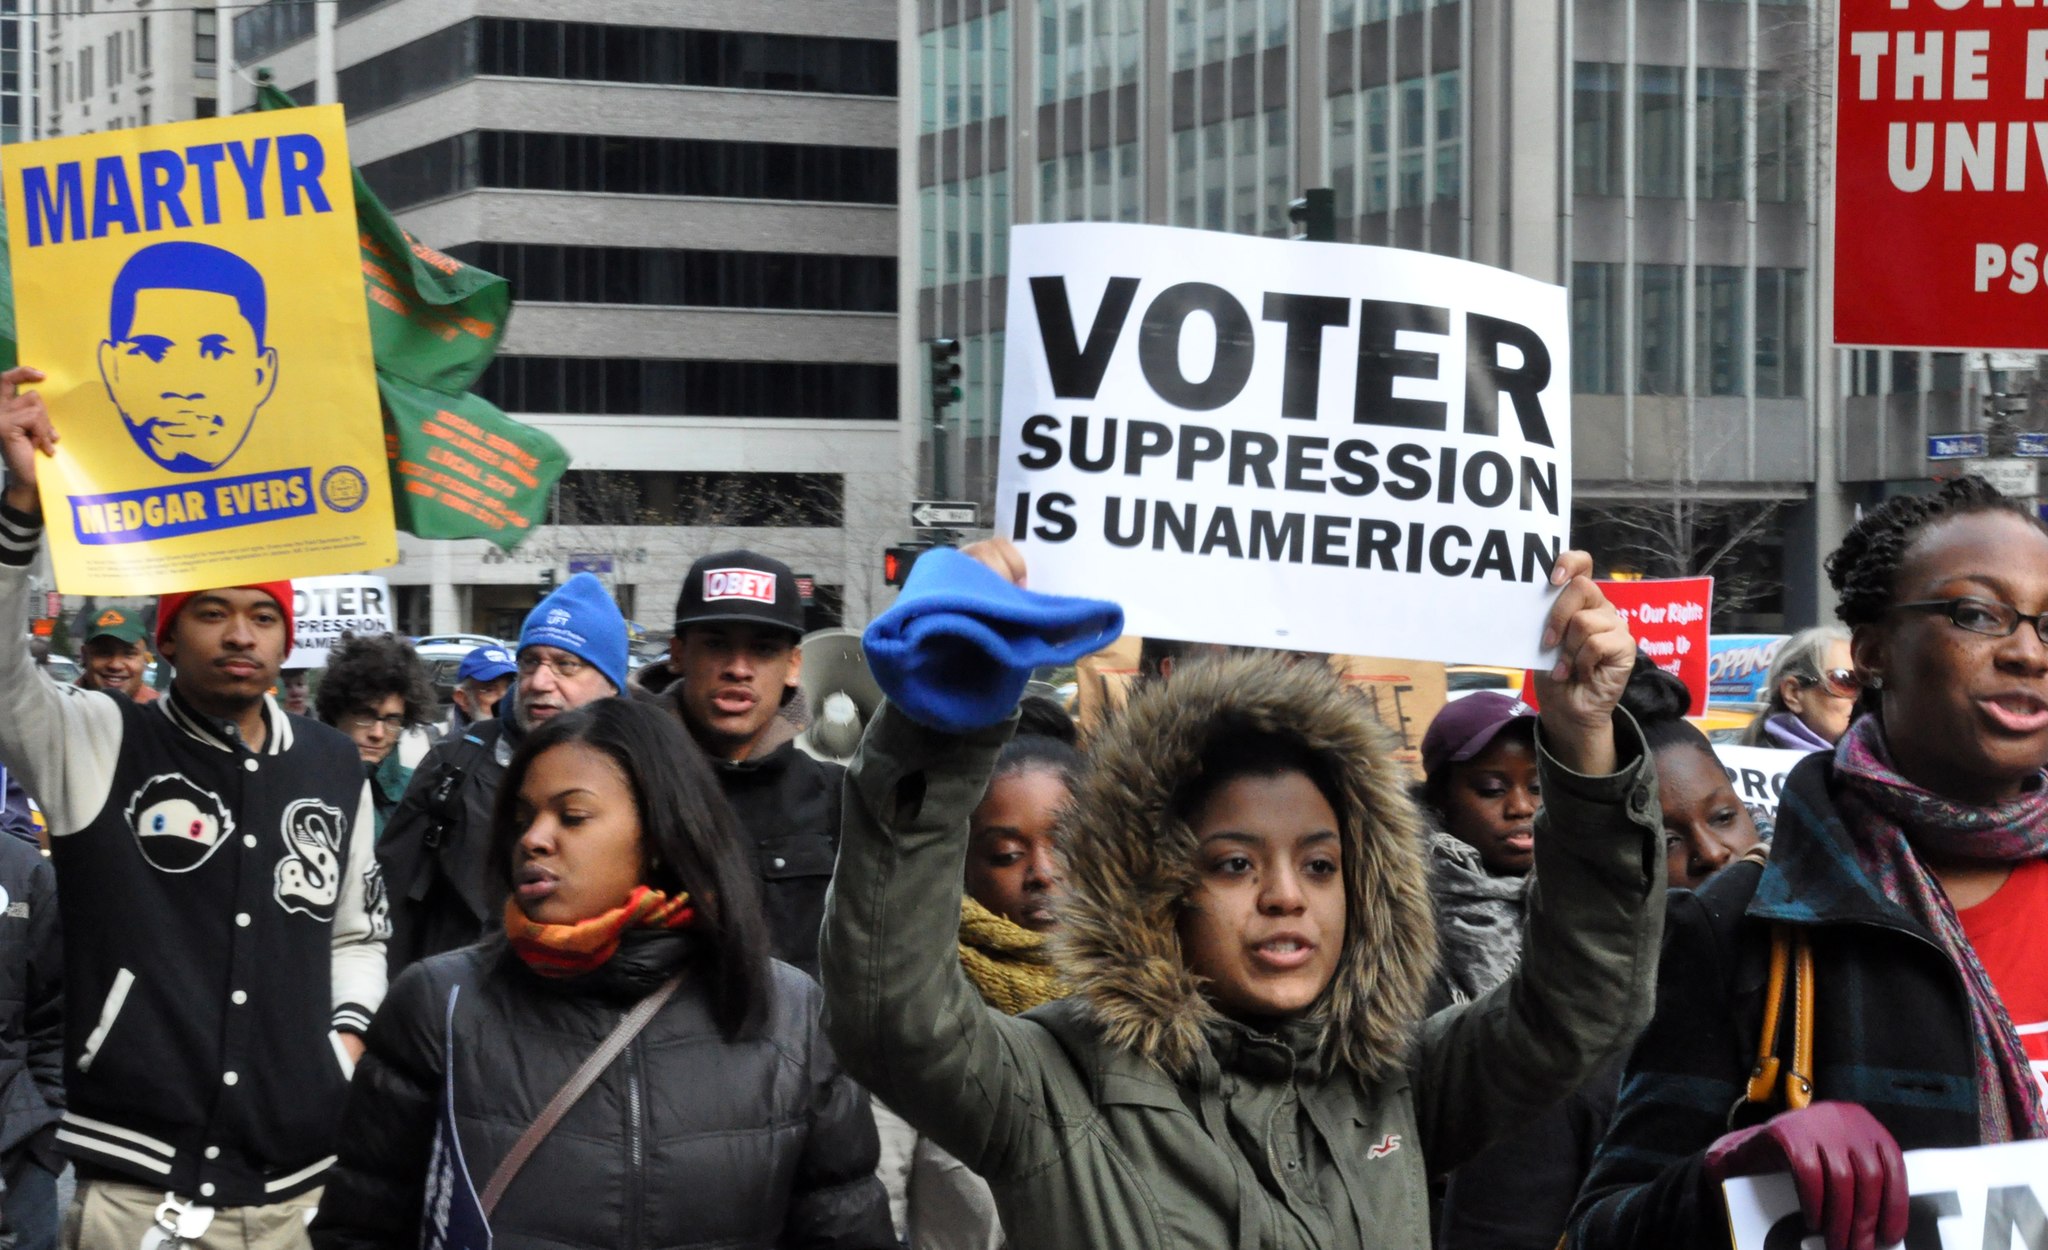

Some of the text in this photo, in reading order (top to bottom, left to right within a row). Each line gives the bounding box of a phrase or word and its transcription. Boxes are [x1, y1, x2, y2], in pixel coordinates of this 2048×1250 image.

[1851, 29, 1990, 100] THE
[21, 133, 333, 247] MARTYR
[1975, 243, 2048, 294] PS
[1028, 275, 1555, 449] VOTER
[1017, 414, 1559, 517] SUPPRESSION
[77, 491, 207, 535] MEDGAR
[215, 476, 308, 518] EVERS
[1012, 492, 1561, 584] IS UNAMERICAN
[710, 572, 772, 598] OBEY
[1639, 603, 1667, 624] Our
